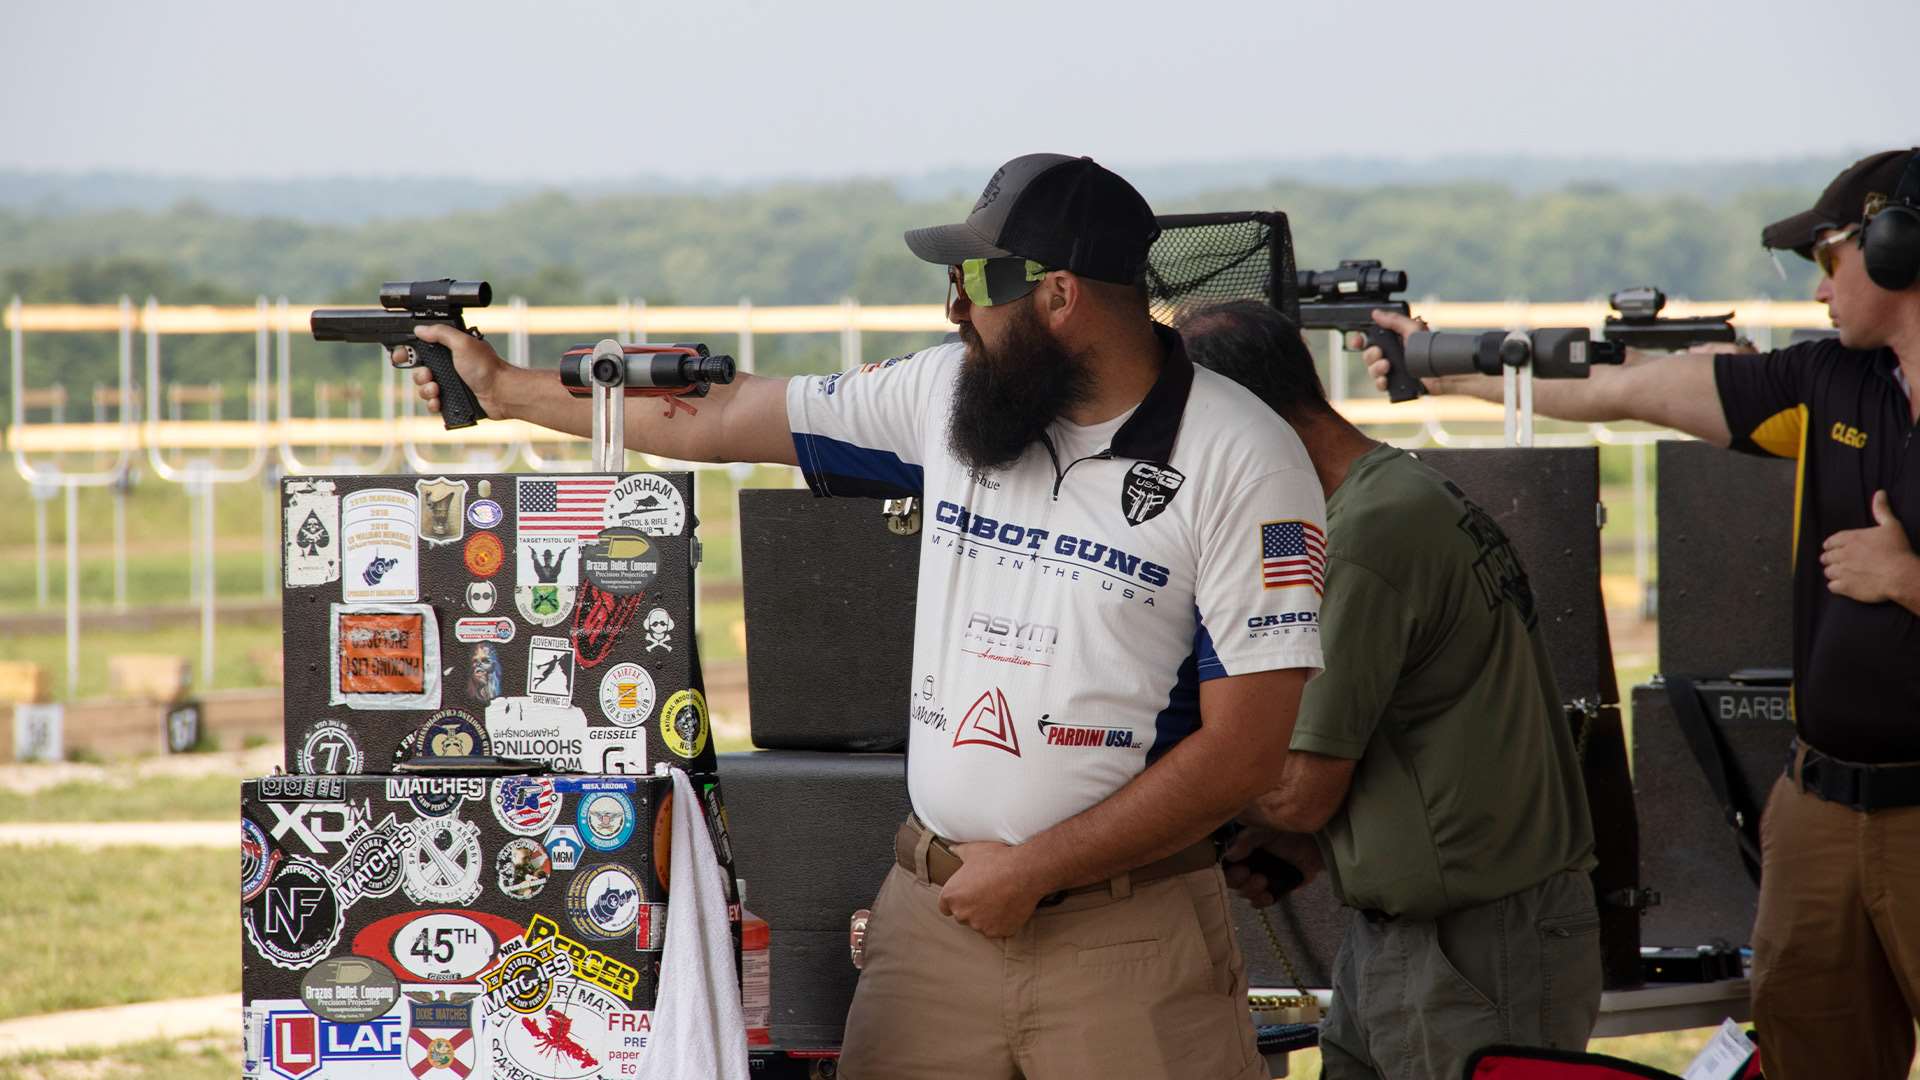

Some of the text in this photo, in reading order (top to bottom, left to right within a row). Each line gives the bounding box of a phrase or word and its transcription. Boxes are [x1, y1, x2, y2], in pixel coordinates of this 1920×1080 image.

[614, 478, 673, 501] DURHAM
[1136, 478, 1161, 492] USA
[622, 519, 643, 527] PISTOL
[651, 518, 668, 526] RIFLE
[586, 560, 657, 574] Brazos Bullet Company
[1054, 534, 1170, 587] GUNS
[997, 556, 1024, 570] IN
[1042, 565, 1080, 581] THE
[1101, 580, 1155, 607] USA
[532, 638, 568, 649] ADVENTURE
[612, 667, 641, 680] FAIRFAX
[533, 695, 561, 705] BREWING
[605, 698, 616, 714] ROD
[493, 727, 560, 738] CHAMPIONSHIP
[589, 730, 637, 739] GEISSELE
[1047, 725, 1105, 748] PARDINI
[1104, 731, 1132, 748] USA
[494, 739, 582, 755] SHOOTING
[390, 778, 482, 798] MATCHES
[345, 825, 367, 846] NRA
[354, 839, 383, 867] NATIONAL
[457, 826, 478, 866] ARMORY
[337, 826, 416, 906] MATCHES
[553, 852, 573, 863] MGM
[368, 881, 382, 889] CAMP
[266, 887, 327, 945] NF
[265, 939, 300, 958] PRECISION
[411, 927, 477, 964] 45TH
[500, 940, 522, 958] NRA
[503, 956, 537, 980] NATIONAL
[306, 986, 394, 1002] Brazos Bullet Company
[416, 1007, 468, 1021] DIXIE MATCHES
[608, 1013, 651, 1032] FRA
[281, 1022, 312, 1064] L
[624, 1037, 648, 1047] PRE
[608, 1050, 640, 1061] paper
